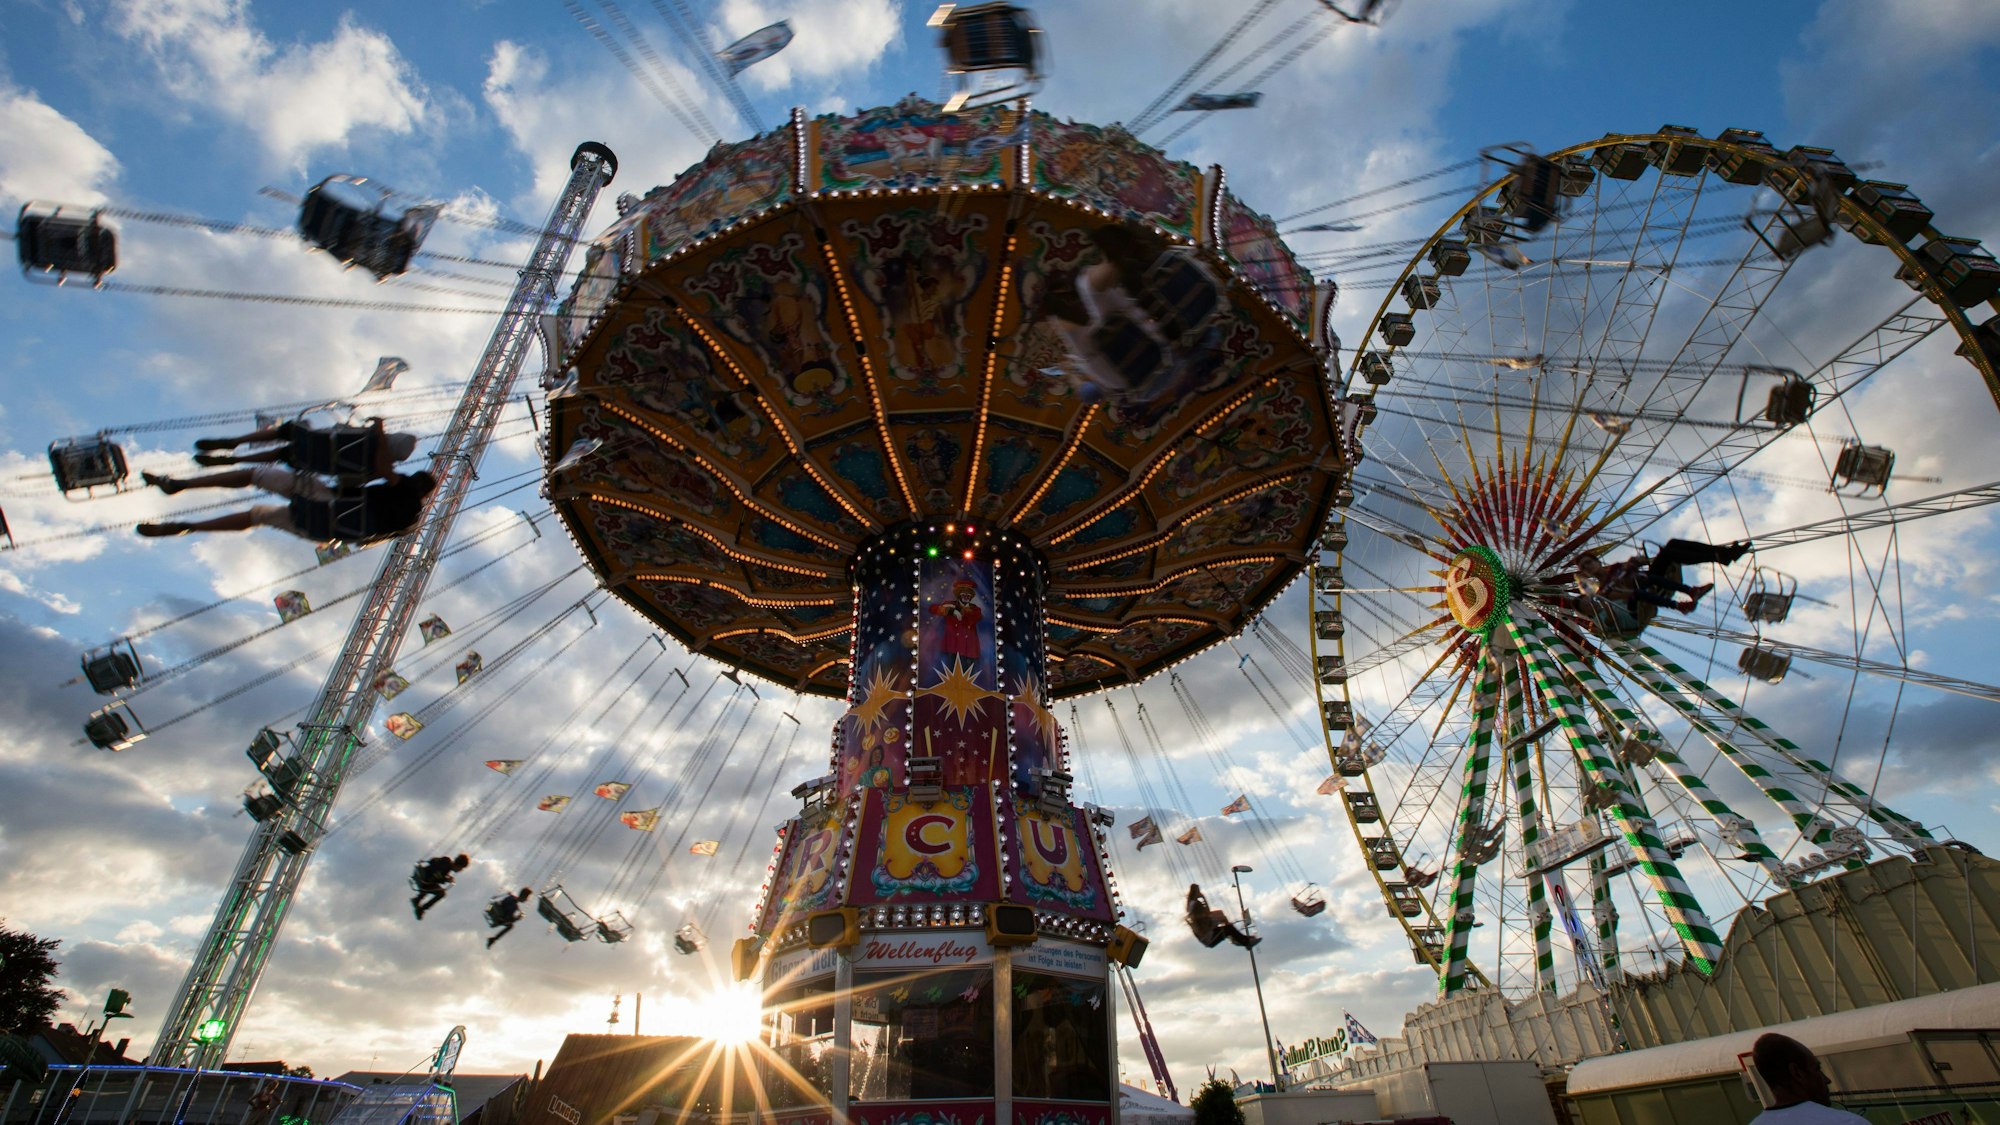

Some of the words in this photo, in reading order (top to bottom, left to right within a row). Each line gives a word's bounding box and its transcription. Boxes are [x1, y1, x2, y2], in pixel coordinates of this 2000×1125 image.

[865, 940, 978, 964] Wellenflug
[1063, 948, 1074, 957] des
[1038, 955, 1054, 967] Folge
[1064, 960, 1083, 970] leisten
[547, 1094, 581, 1125] LANGOS
